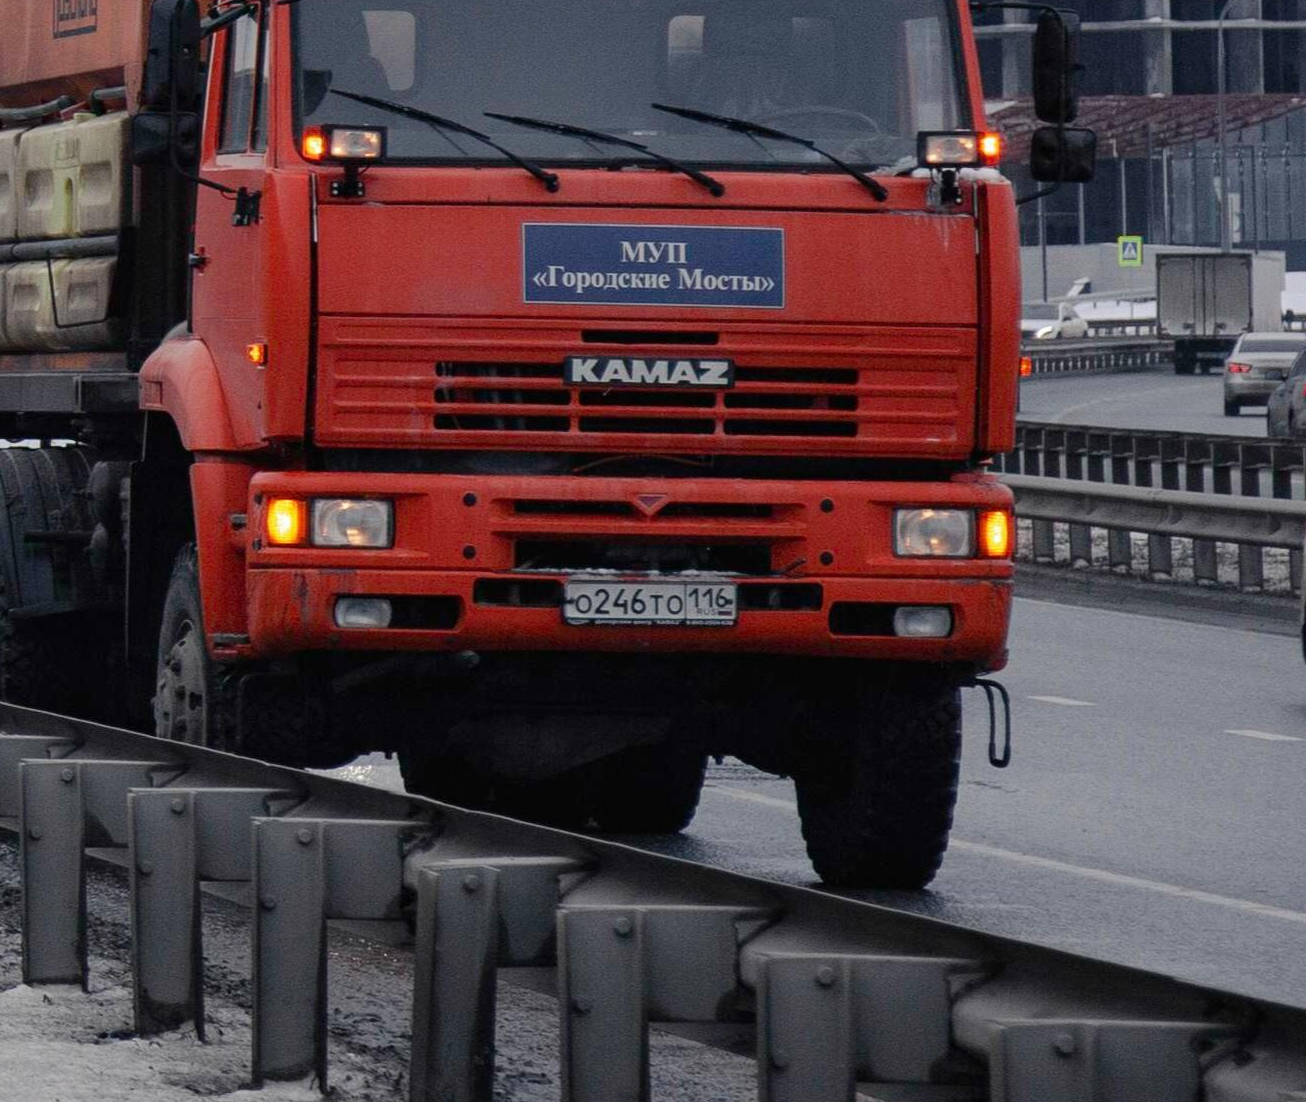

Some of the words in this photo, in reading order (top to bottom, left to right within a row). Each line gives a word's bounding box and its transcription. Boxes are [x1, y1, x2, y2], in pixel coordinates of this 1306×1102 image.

[620, 241, 688, 264] МУП
[533, 265, 671, 294] «Городские
[678, 267, 776, 292] Мосты»
[571, 358, 730, 385] KAMAZ
[688, 588, 728, 608] 116
